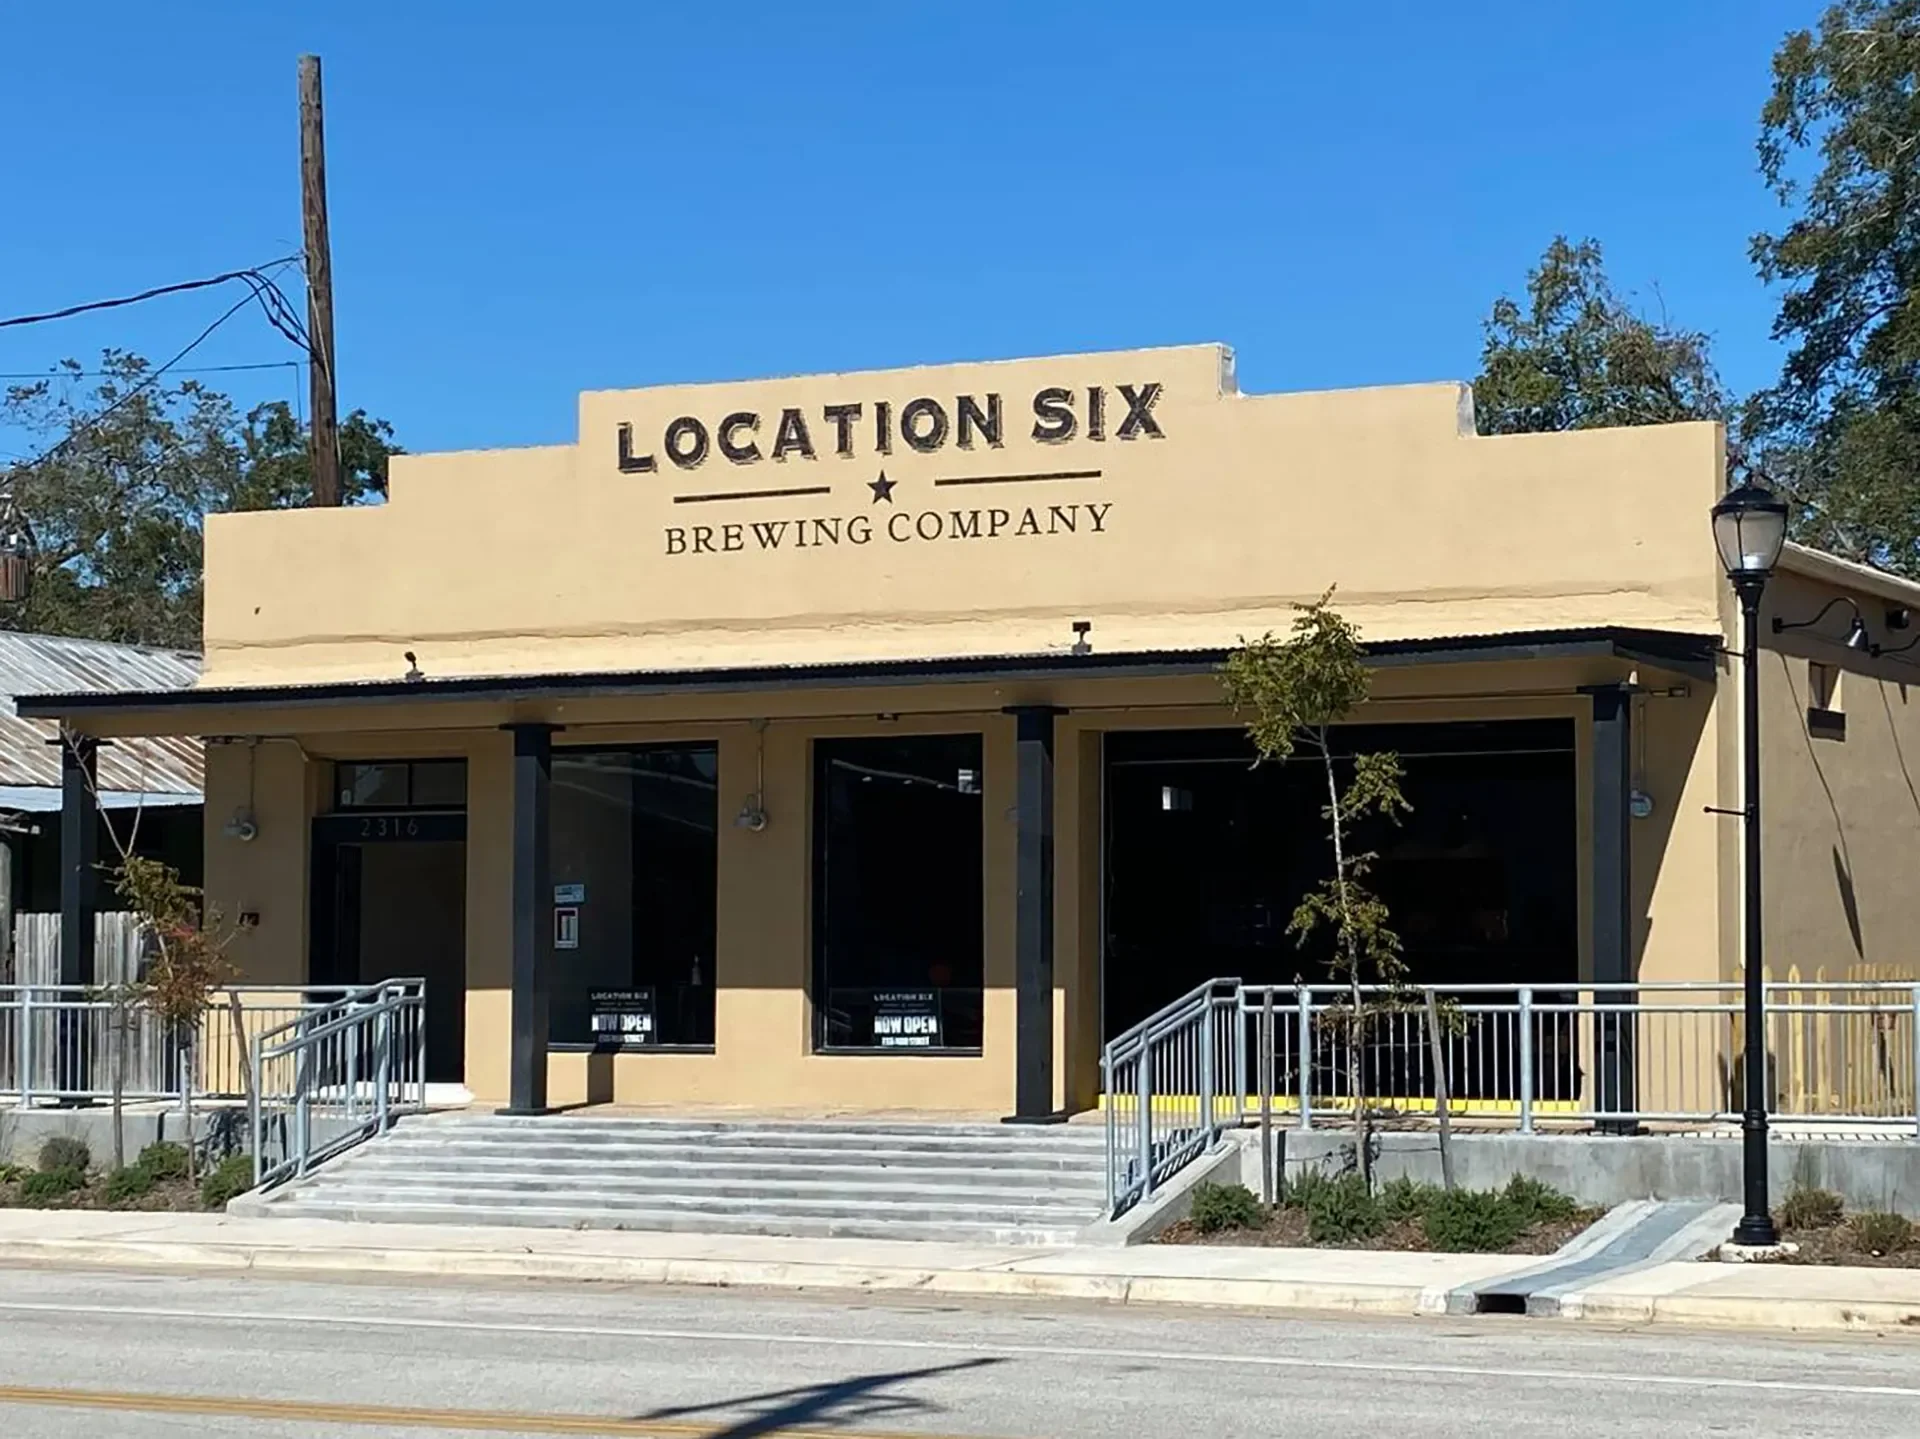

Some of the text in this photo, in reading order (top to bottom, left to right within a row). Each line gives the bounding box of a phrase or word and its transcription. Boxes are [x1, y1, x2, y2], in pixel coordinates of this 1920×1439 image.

[617, 383, 1166, 474] LOCATION SIX
[665, 503, 1113, 555] BREWING COMPANY
[361, 818, 419, 837] 2316
[592, 1013, 652, 1031] NOW OPEN
[874, 1015, 938, 1034] NOW OPEN
